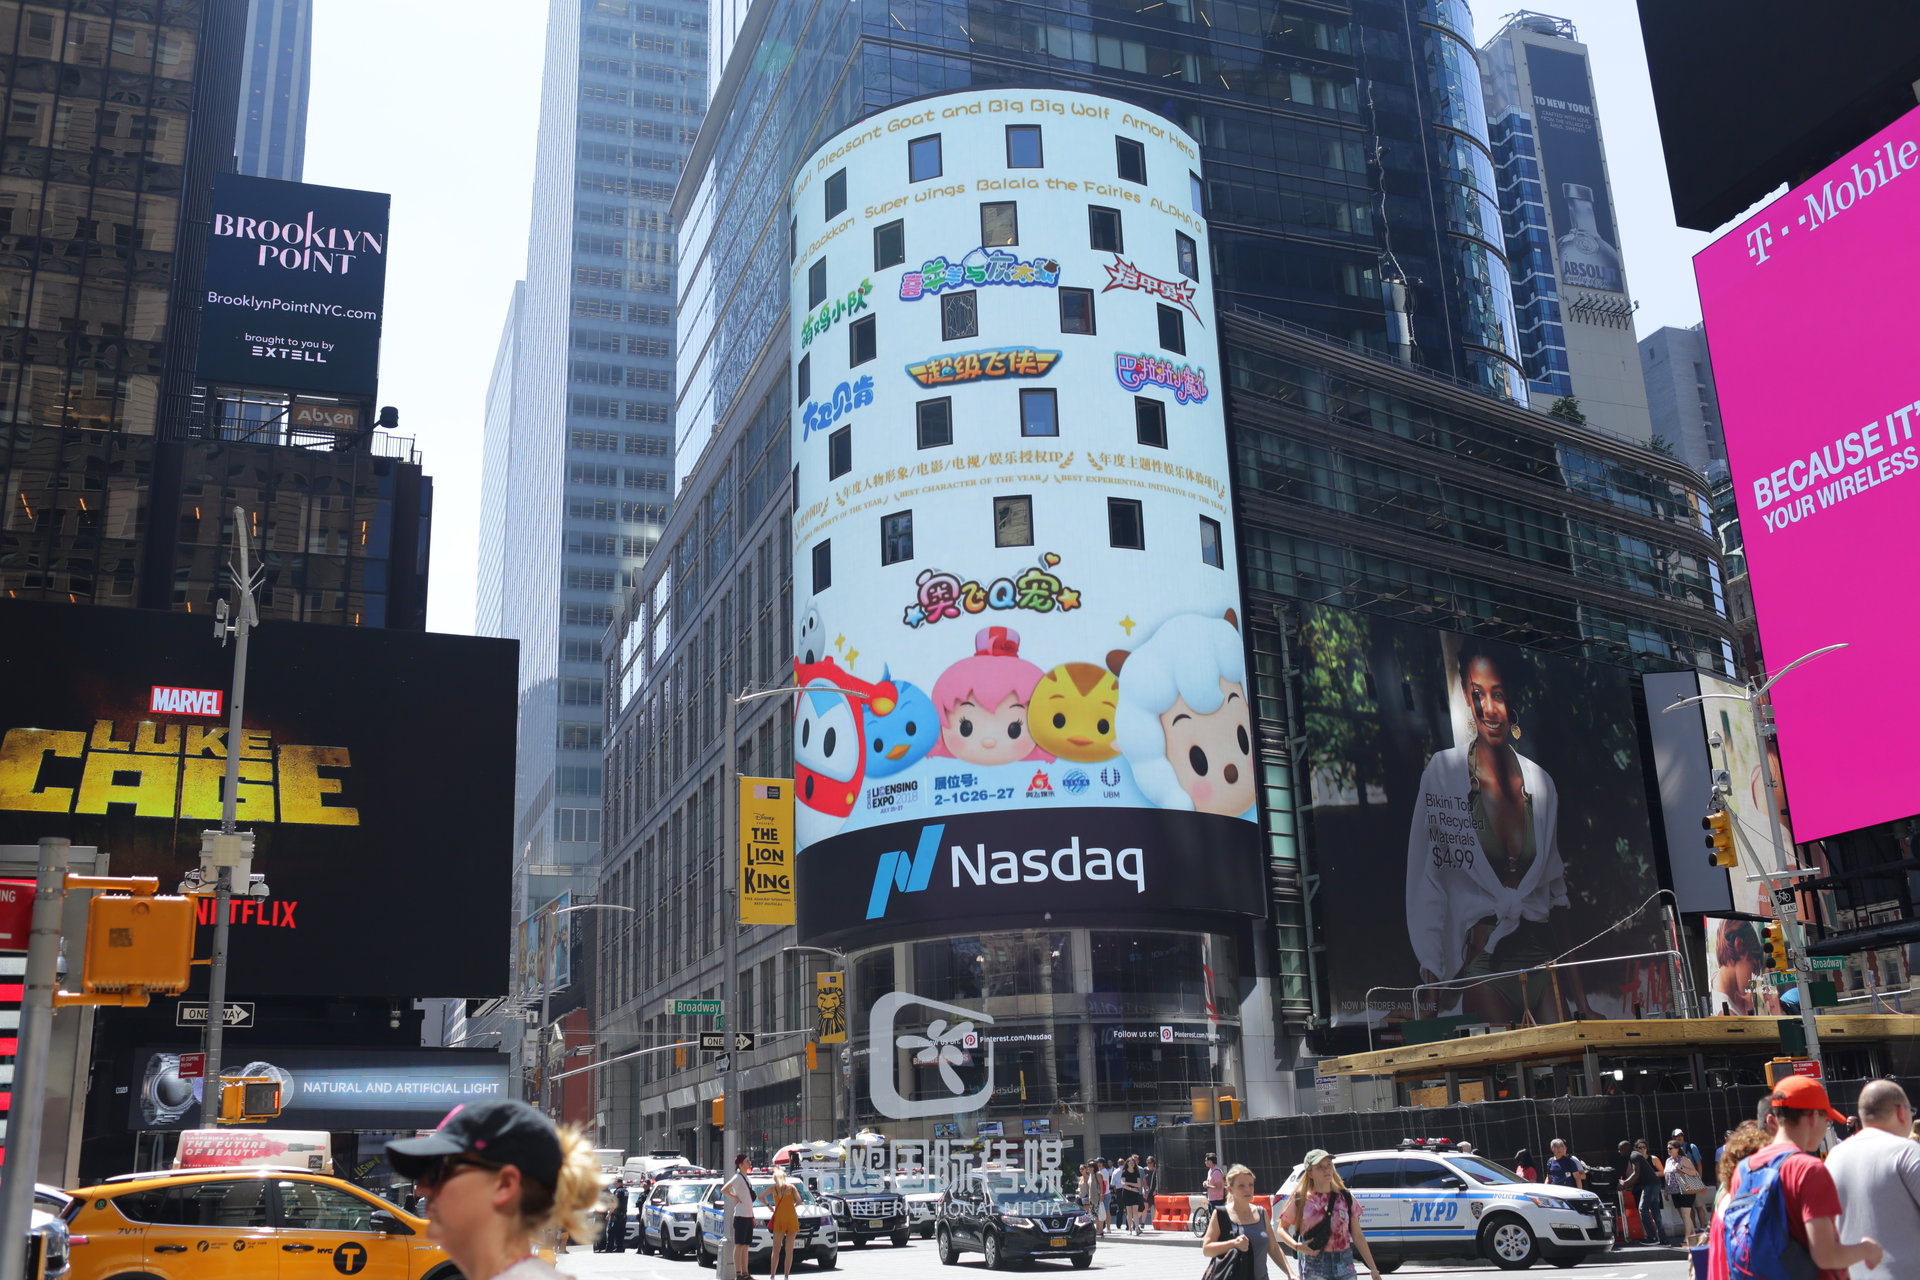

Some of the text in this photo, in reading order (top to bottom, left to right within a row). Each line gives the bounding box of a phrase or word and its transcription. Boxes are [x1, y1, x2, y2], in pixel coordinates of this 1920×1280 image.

[1534, 95, 1546, 105] TO
[1547, 98, 1565, 110] NEW
[887, 110, 935, 133] Goat
[942, 102, 981, 118] and
[988, 99, 1023, 113] Big
[1030, 99, 1065, 115] Big
[1070, 102, 1110, 120] Wolf
[1122, 114, 1165, 139] Armor
[1169, 132, 1195, 160] Hero
[808, 217, 855, 256] Backkom
[864, 195, 909, 220] Super
[976, 178, 1040, 191] Balala
[1045, 178, 1078, 191] the
[1084, 180, 1141, 204] Fairies
[258, 244, 357, 275] POINT
[207, 291, 377, 321] BrooklynPointNYC.com
[801, 278, 873, 350] 萌鸡小队
[244, 332, 334, 351] brought to you by
[252, 346, 326, 363] EXTELL
[915, 347, 1052, 386] 超级飞侠
[297, 407, 354, 427] Absen
[1753, 421, 1884, 510] BECAUSE
[980, 478, 992, 486] OF
[995, 476, 1014, 484] THE
[1017, 474, 1041, 482] YEAR
[1762, 446, 1919, 534] YOUR WIRELESS
[152, 687, 222, 716] MARVEL
[90, 719, 272, 760] LUKE
[0, 727, 360, 826] CAGE
[872, 780, 918, 798] LICENSING
[934, 788, 1015, 806] 2-1C26-27
[872, 792, 919, 808] EXPO 2018
[1426, 793, 1473, 814] Bikini Top
[1428, 811, 1484, 831] in Recycled
[752, 828, 778, 840] THE
[1429, 829, 1475, 846] Materials
[747, 843, 784, 866] LION
[1432, 845, 1475, 870] $4.99
[951, 836, 1146, 893] Nasdaq
[744, 867, 790, 894] KING
[0, 890, 16, 903] NG
[1784, 903, 1796, 912] LANE
[1812, 957, 1843, 969] Broadway
[1618, 958, 1668, 1017] H&M
[1771, 974, 1779, 983] W
[1781, 973, 1788, 982] 43
[189, 1009, 243, 1020] ONE WAY
[677, 1001, 720, 1015] Broadway
[1342, 1001, 1358, 1010] NOW
[1369, 1001, 1395, 1010] STORES
[1397, 1002, 1411, 1010] AND
[1414, 1002, 1437, 1011] NLINE
[707, 1037, 747, 1046] ONE AY
[1113, 1030, 1138, 1038] Follow
[304, 1082, 500, 1094] NATURAL AND ARTIFICIAL LIGHT
[185, 1148, 204, 1156] OF
[186, 1140, 267, 1148] THE FUTURE
[1410, 1201, 1458, 1222] NYPD
[117, 1227, 144, 1235] 7V11
[341, 1248, 361, 1271] T
